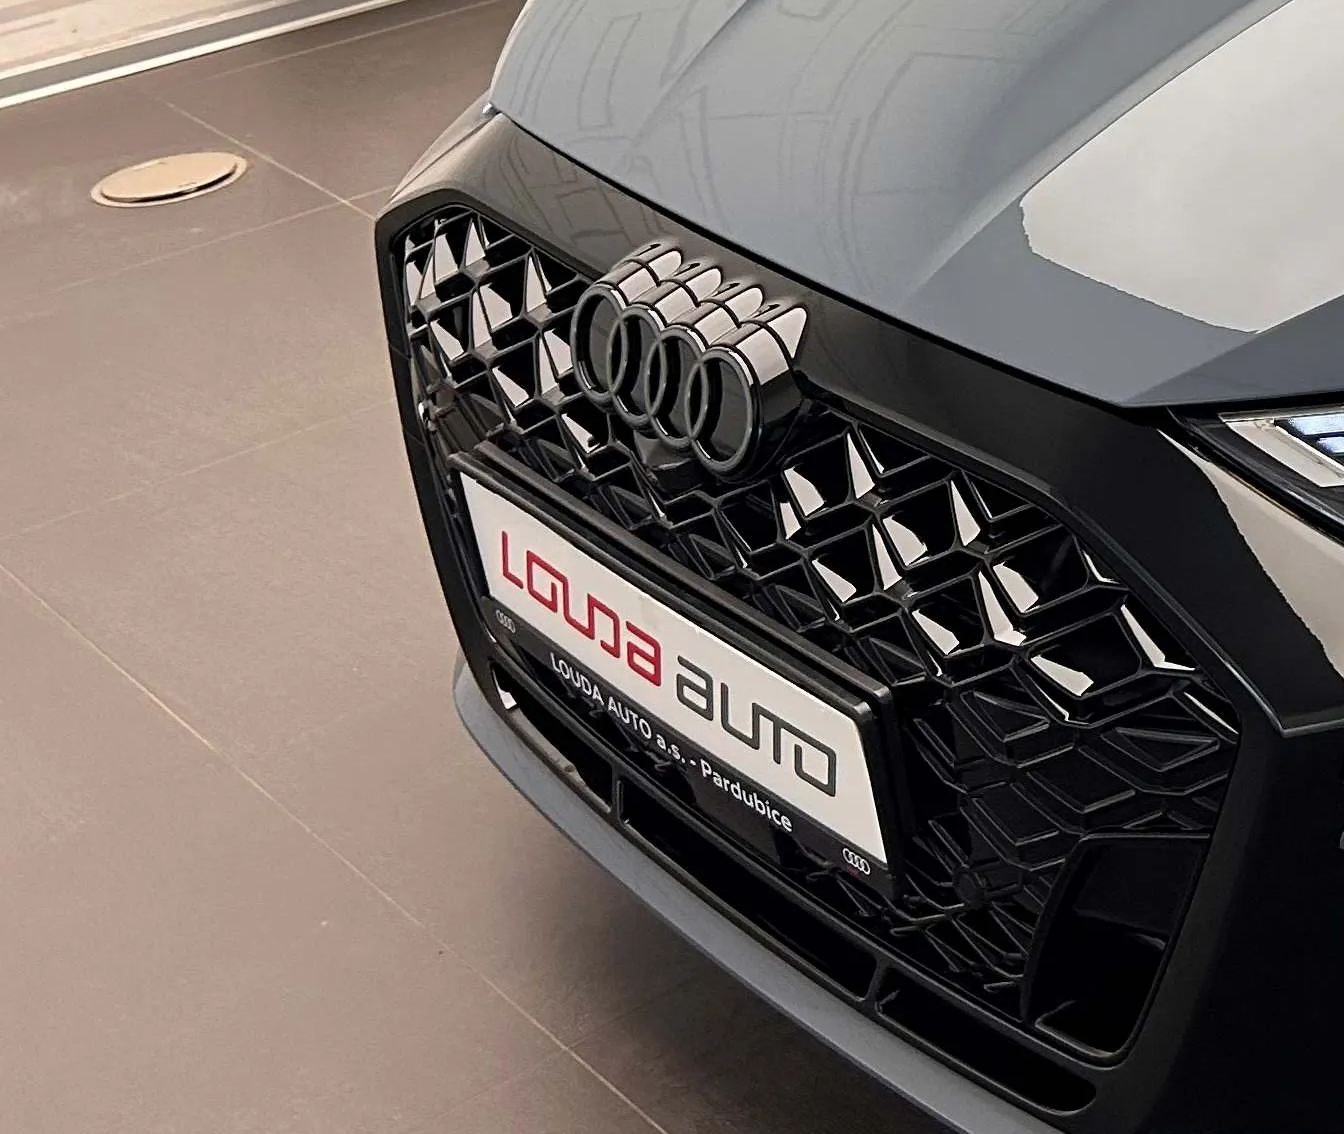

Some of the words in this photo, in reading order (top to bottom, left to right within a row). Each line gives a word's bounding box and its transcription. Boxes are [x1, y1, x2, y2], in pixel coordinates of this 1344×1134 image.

[550, 652, 605, 706] LOUDA
[607, 696, 652, 740] AUTO
[656, 733, 686, 764] a.s.
[700, 758, 793, 833] Pardubice
